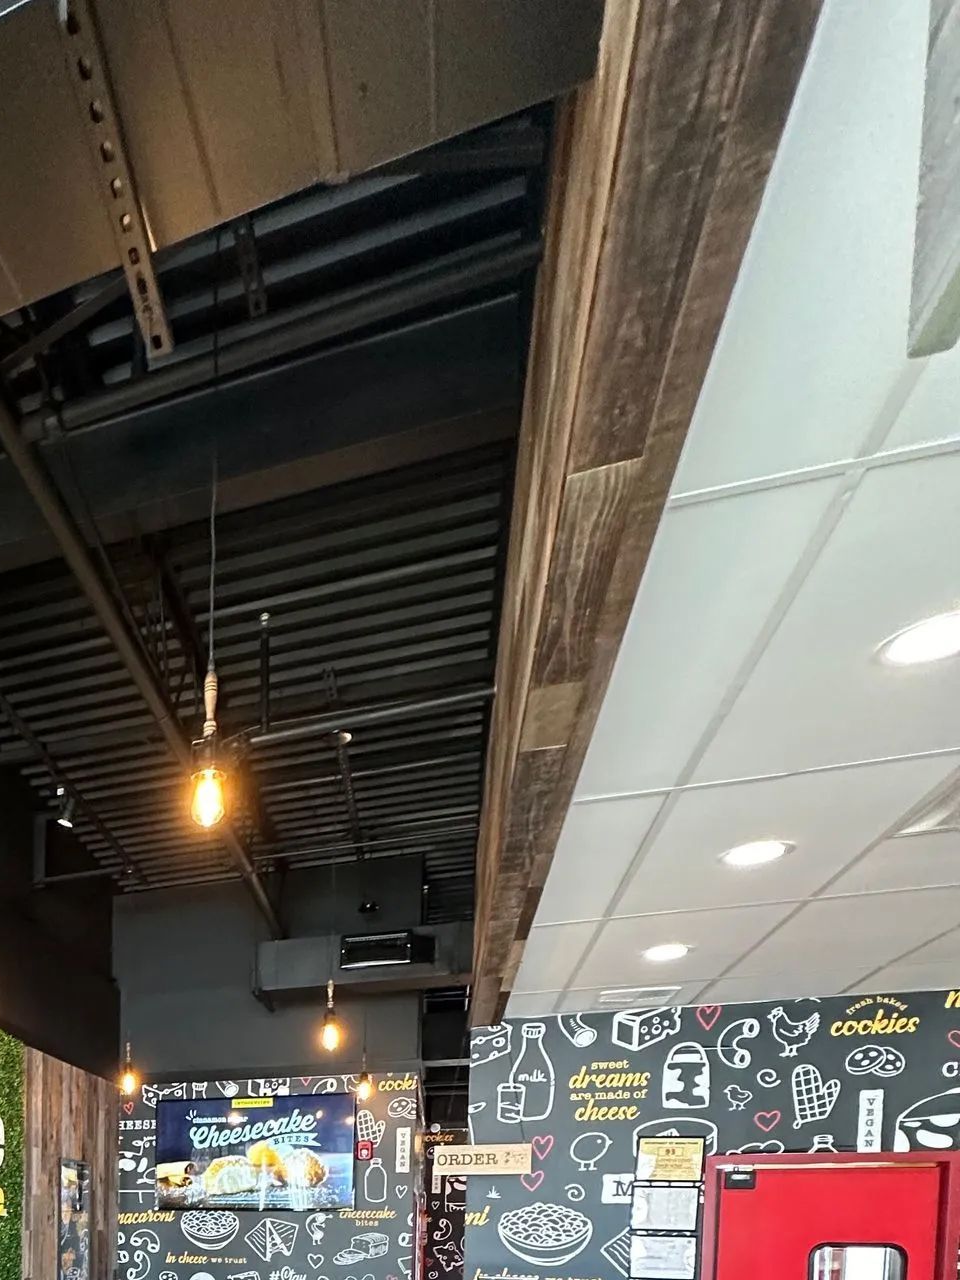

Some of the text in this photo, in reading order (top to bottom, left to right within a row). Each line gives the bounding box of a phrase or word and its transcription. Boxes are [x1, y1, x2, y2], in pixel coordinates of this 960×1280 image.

[846, 995, 909, 1015] fresh baked
[830, 1008, 920, 1036] cookies
[591, 1059, 630, 1070] sweet
[518, 1069, 548, 1083] milk
[568, 1065, 651, 1089] dreams
[569, 1088, 649, 1101] are made of
[574, 1098, 641, 1121] cheese
[189, 1108, 318, 1149] Cheesecake
[863, 1098, 877, 1148] VEGAN
[274, 1135, 310, 1145] BITES
[399, 1132, 407, 1168] VEGAN
[437, 1153, 499, 1167] ORDER
[355, 1219, 380, 1227] bites
[165, 1251, 177, 1264] In
[178, 1250, 210, 1265] cheese
[225, 1256, 248, 1265] trust
